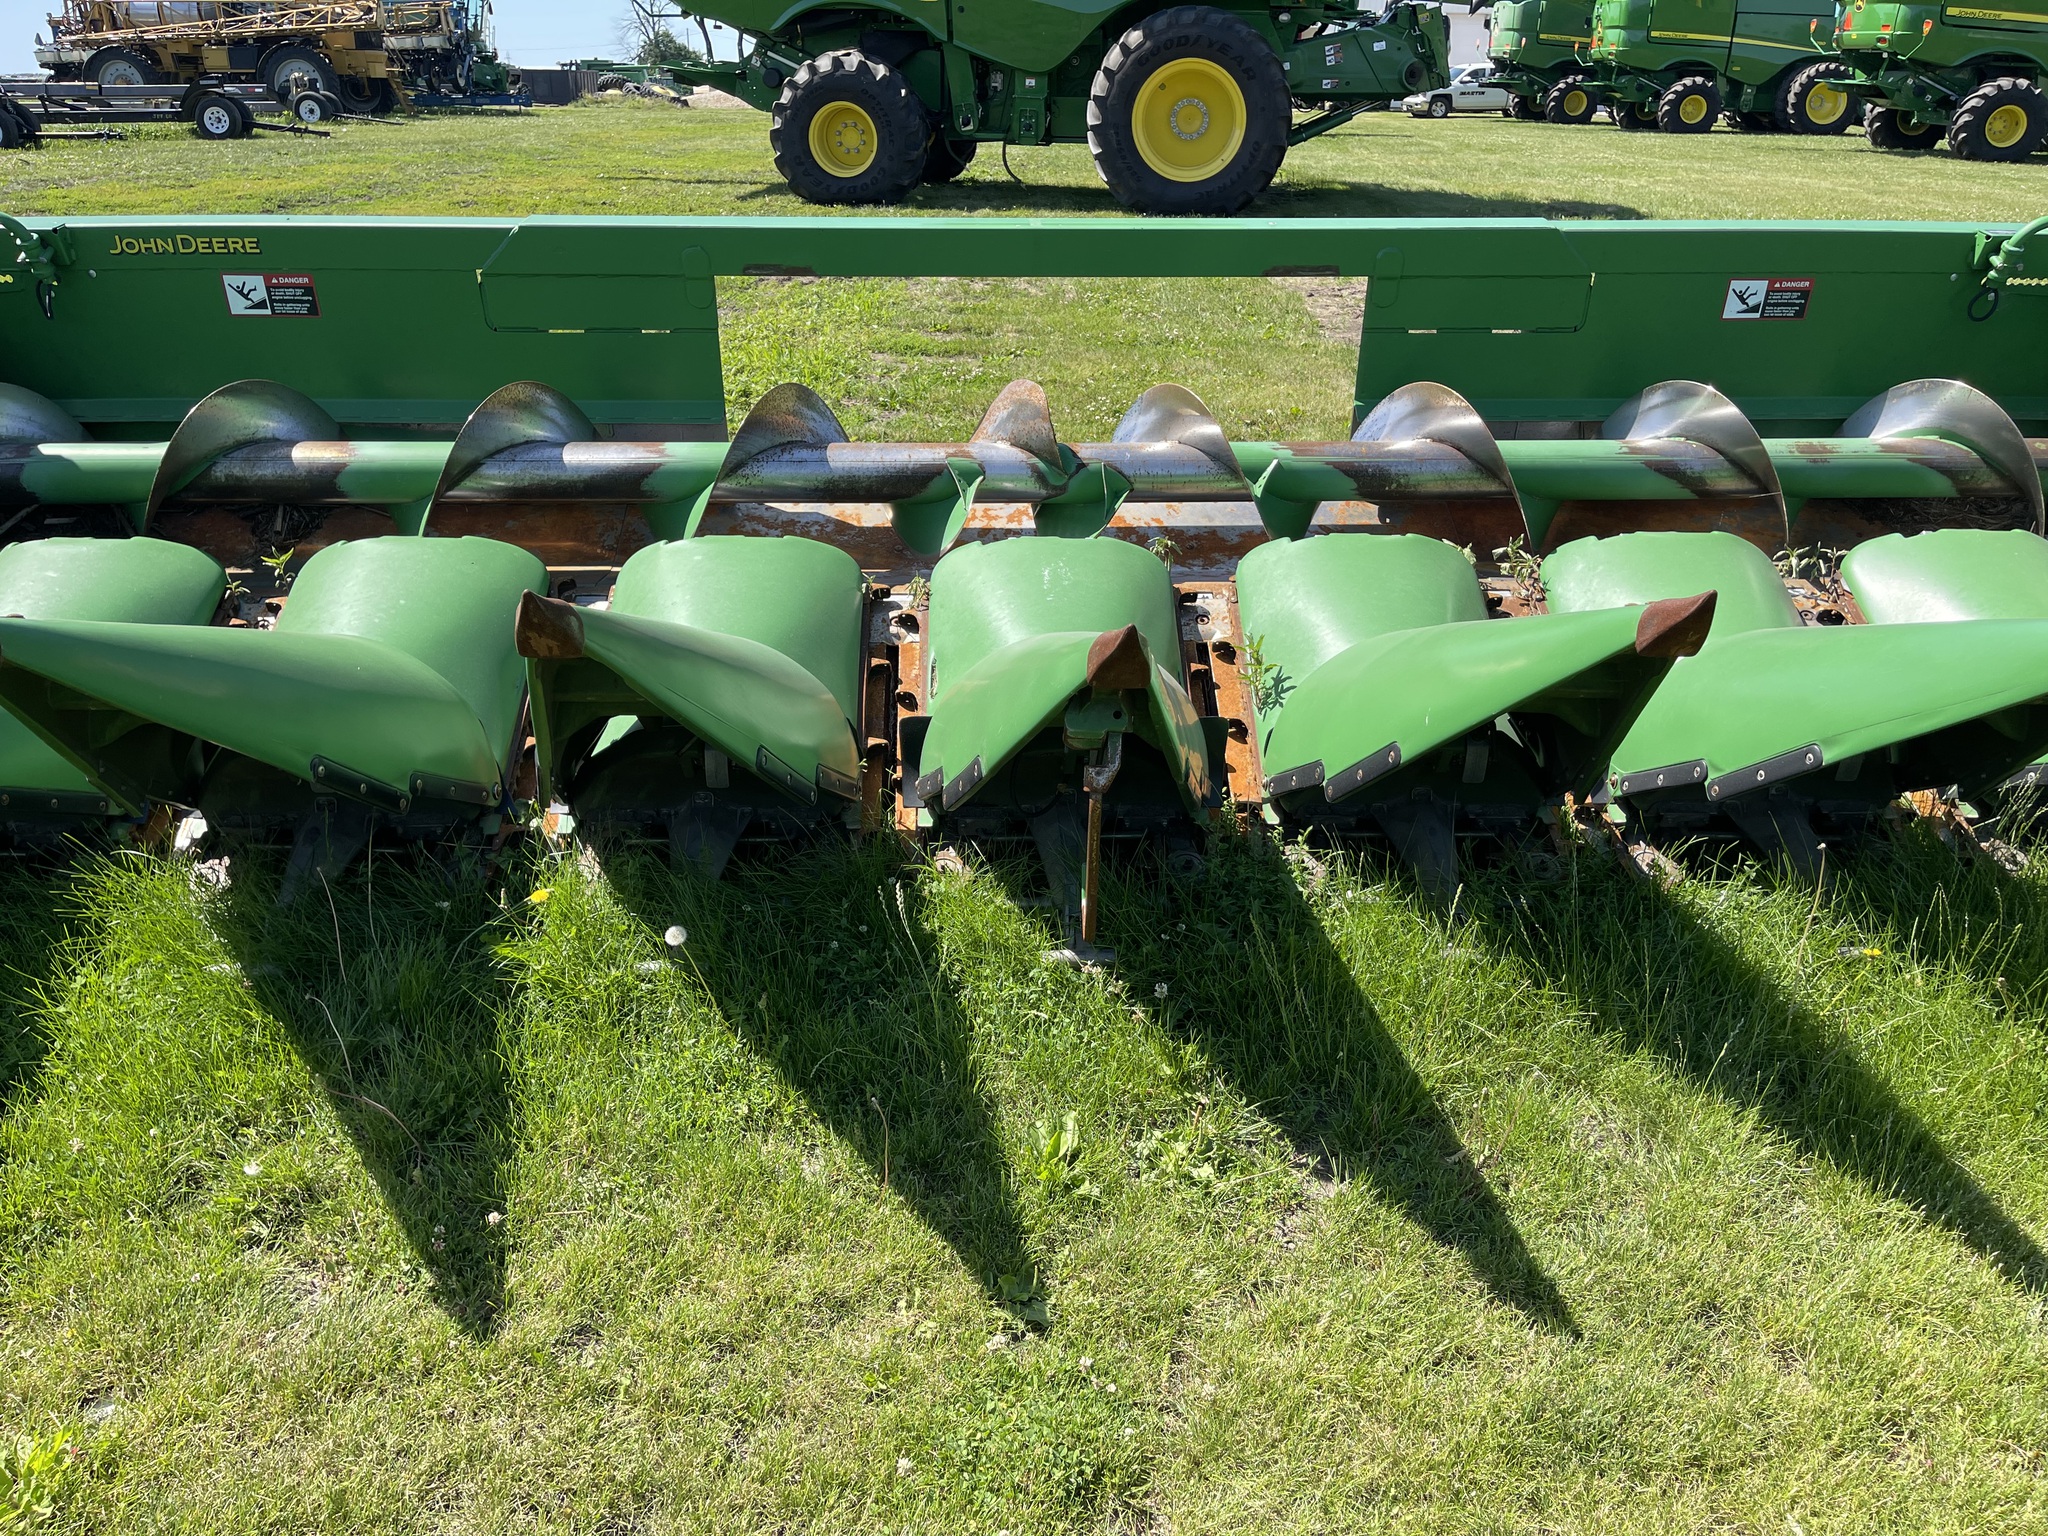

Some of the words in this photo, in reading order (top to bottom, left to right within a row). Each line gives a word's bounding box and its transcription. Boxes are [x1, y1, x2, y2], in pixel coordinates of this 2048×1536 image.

[1956, 9, 1976, 17] JOHN
[1977, 10, 2003, 19] DEERE
[109, 235, 176, 255] JOHN
[175, 234, 262, 255] DEERE
